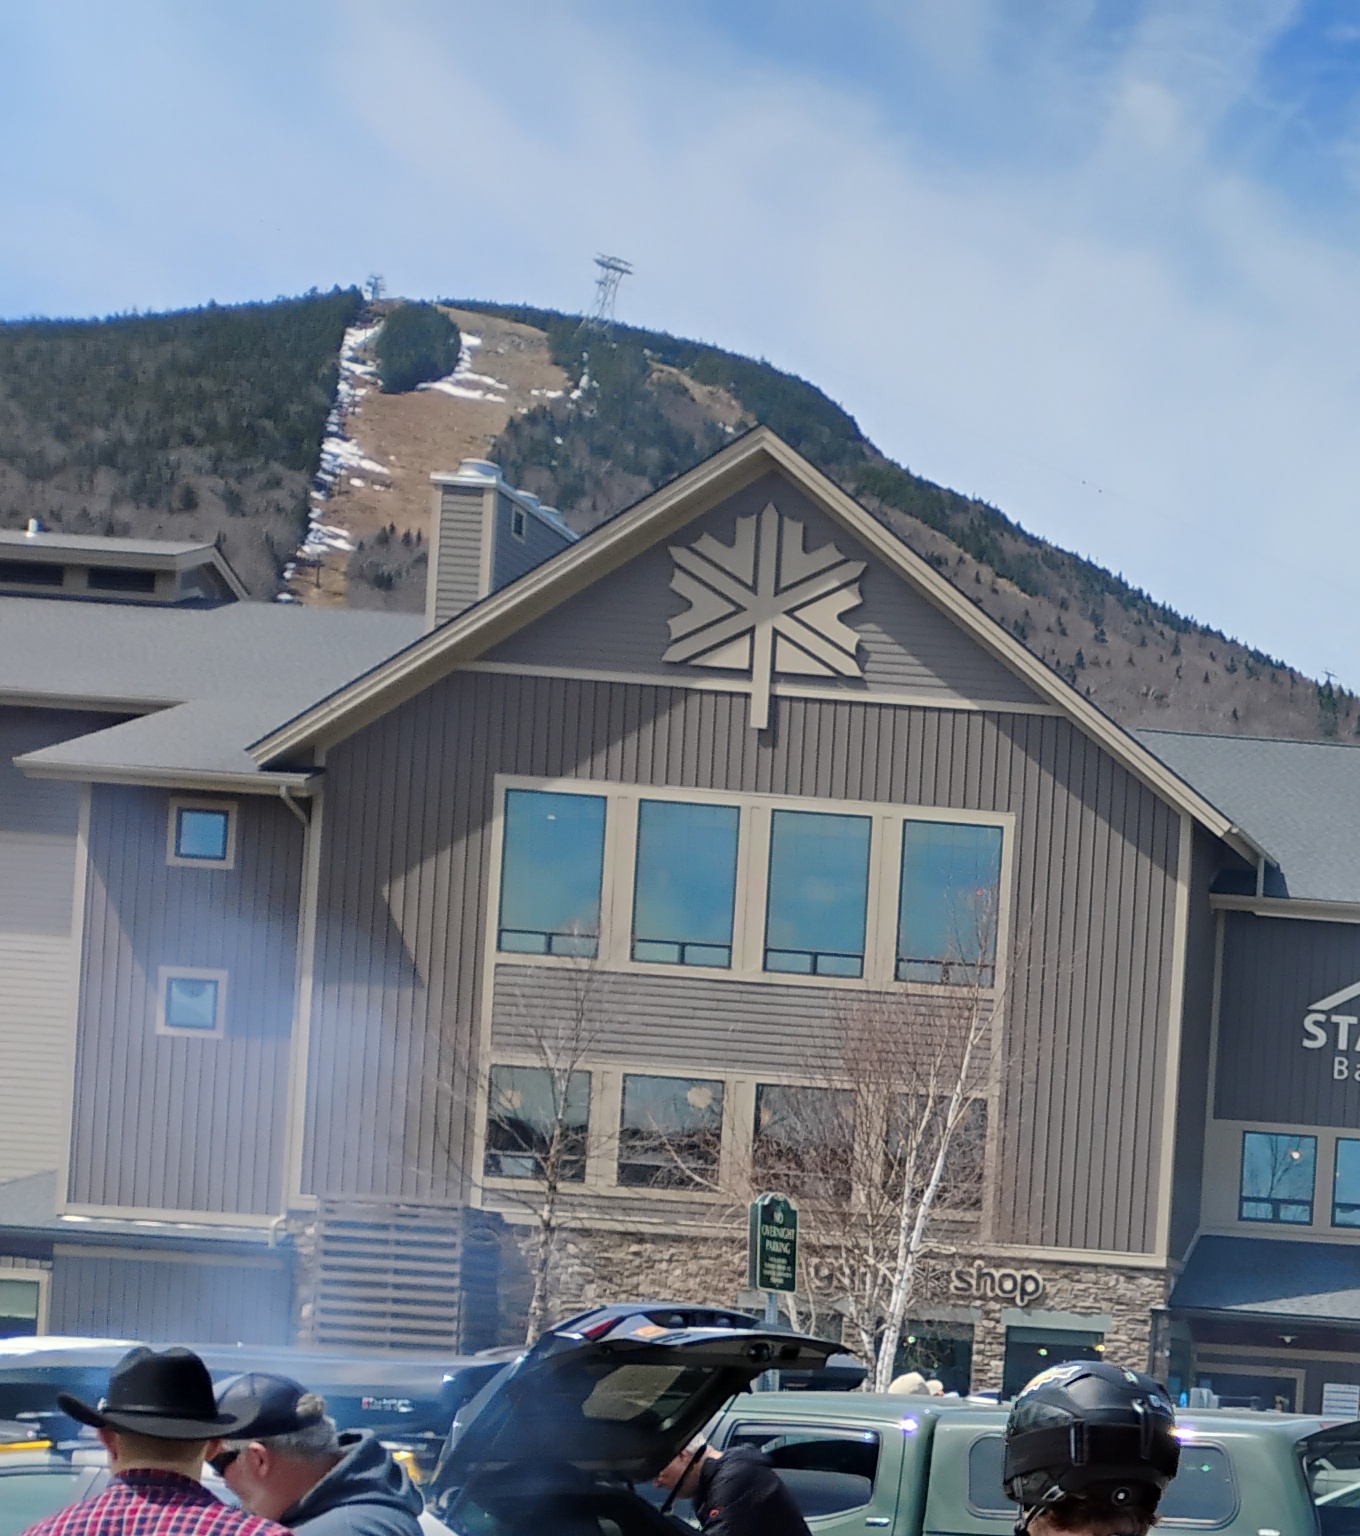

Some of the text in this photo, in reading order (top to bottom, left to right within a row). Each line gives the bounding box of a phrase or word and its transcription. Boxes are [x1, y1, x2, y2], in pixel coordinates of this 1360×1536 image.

[761, 1225, 795, 1240] OVERNIGHT
[765, 1240, 791, 1254] PARKING
[953, 1261, 1042, 1306] shop
